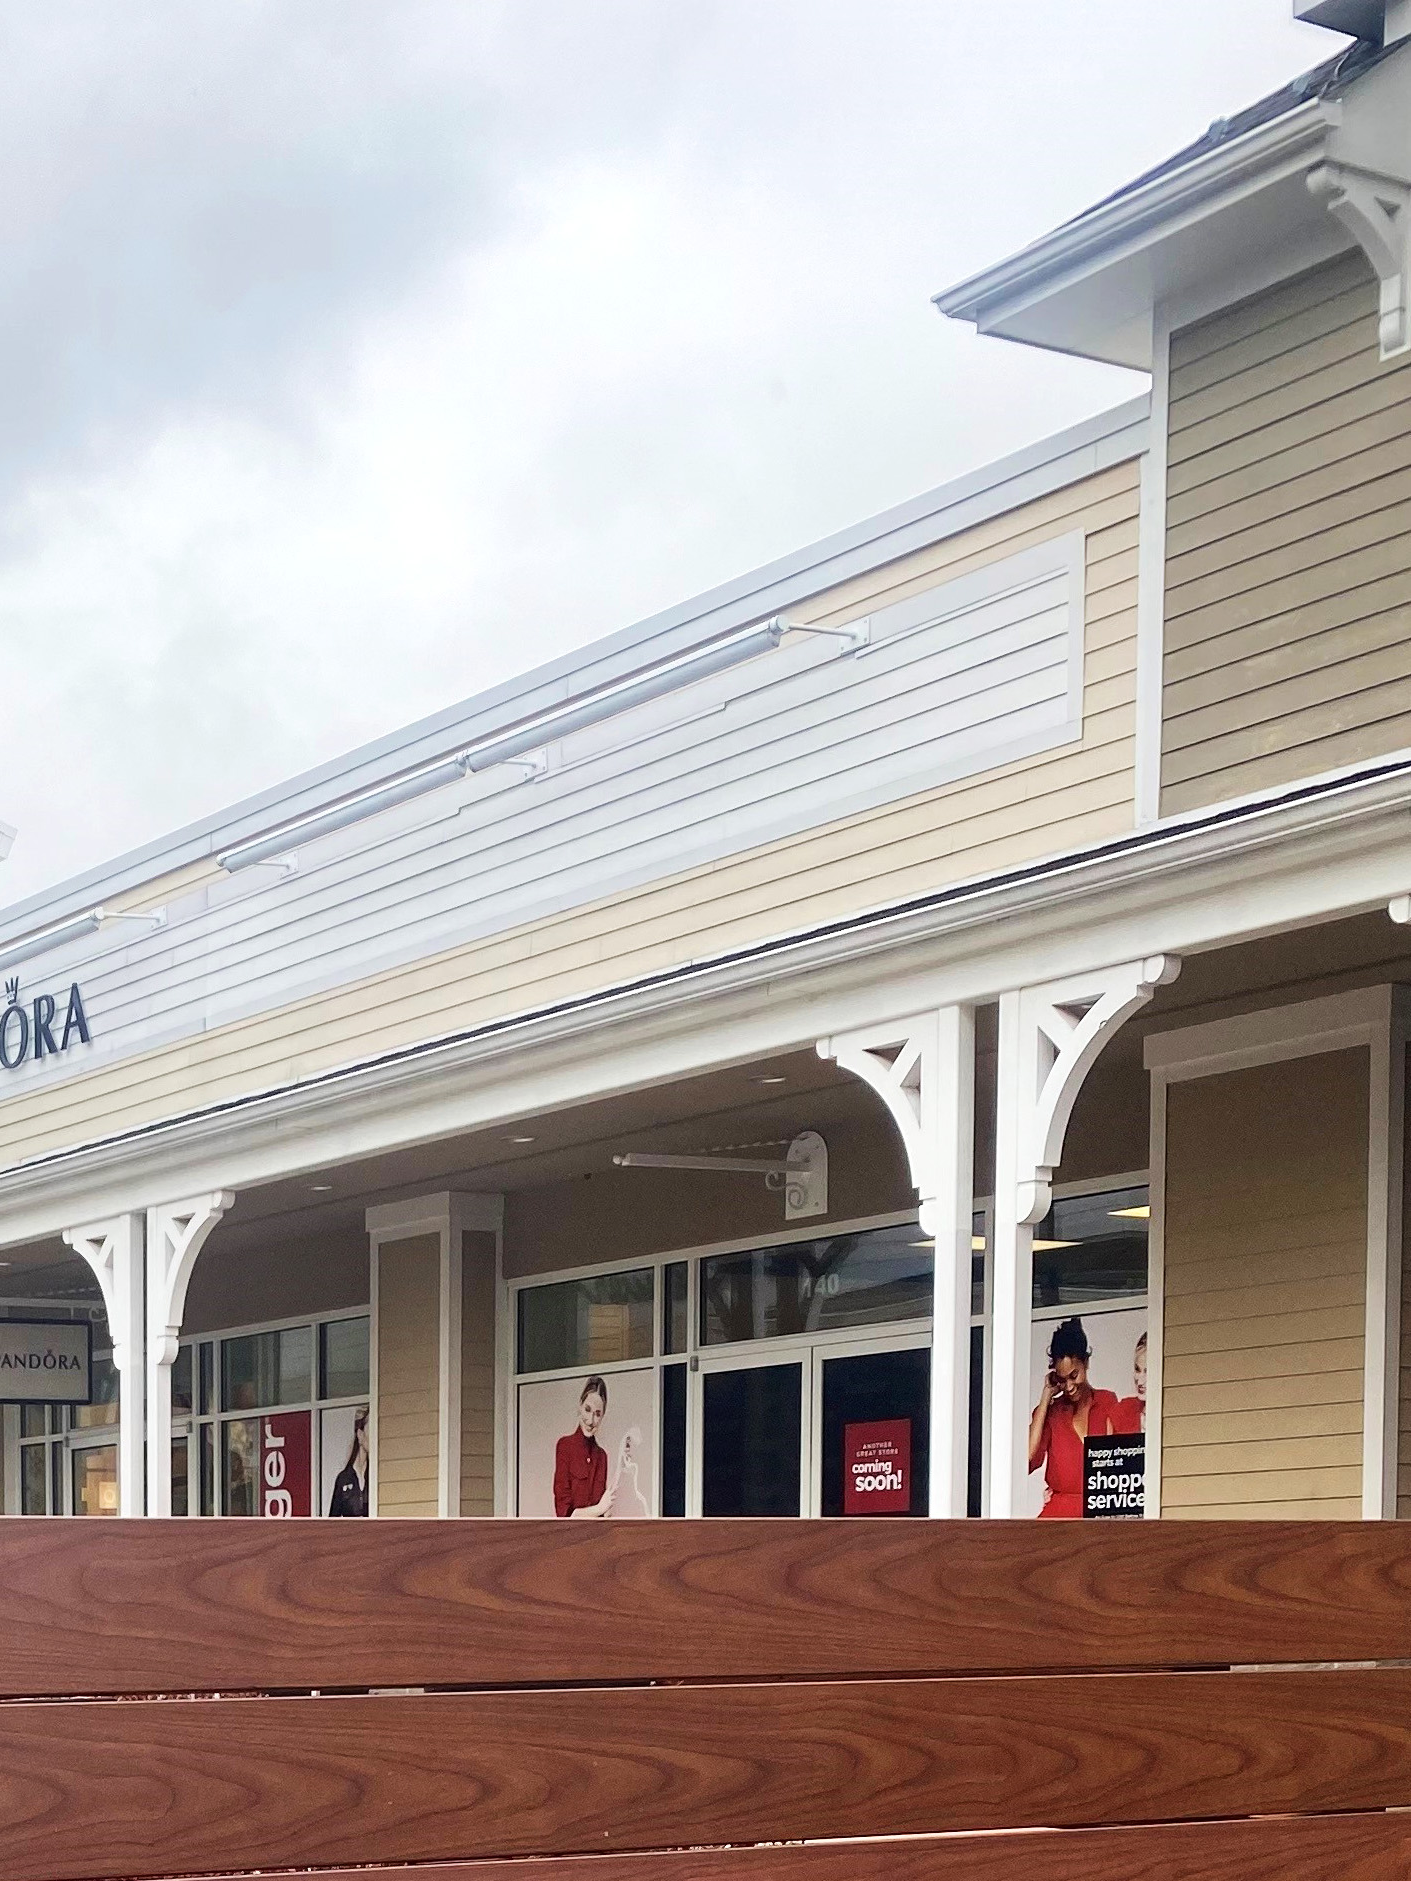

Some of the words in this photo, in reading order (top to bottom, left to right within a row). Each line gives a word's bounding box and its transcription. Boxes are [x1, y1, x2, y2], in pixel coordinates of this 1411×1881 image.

[1088, 1448, 1113, 1458] happy
[852, 1459, 892, 1474] coming
[1092, 1459, 1114, 1468] starts
[1115, 1458, 1123, 1466] at
[855, 1470, 902, 1492] soon!
[1087, 1489, 1145, 1509] service
